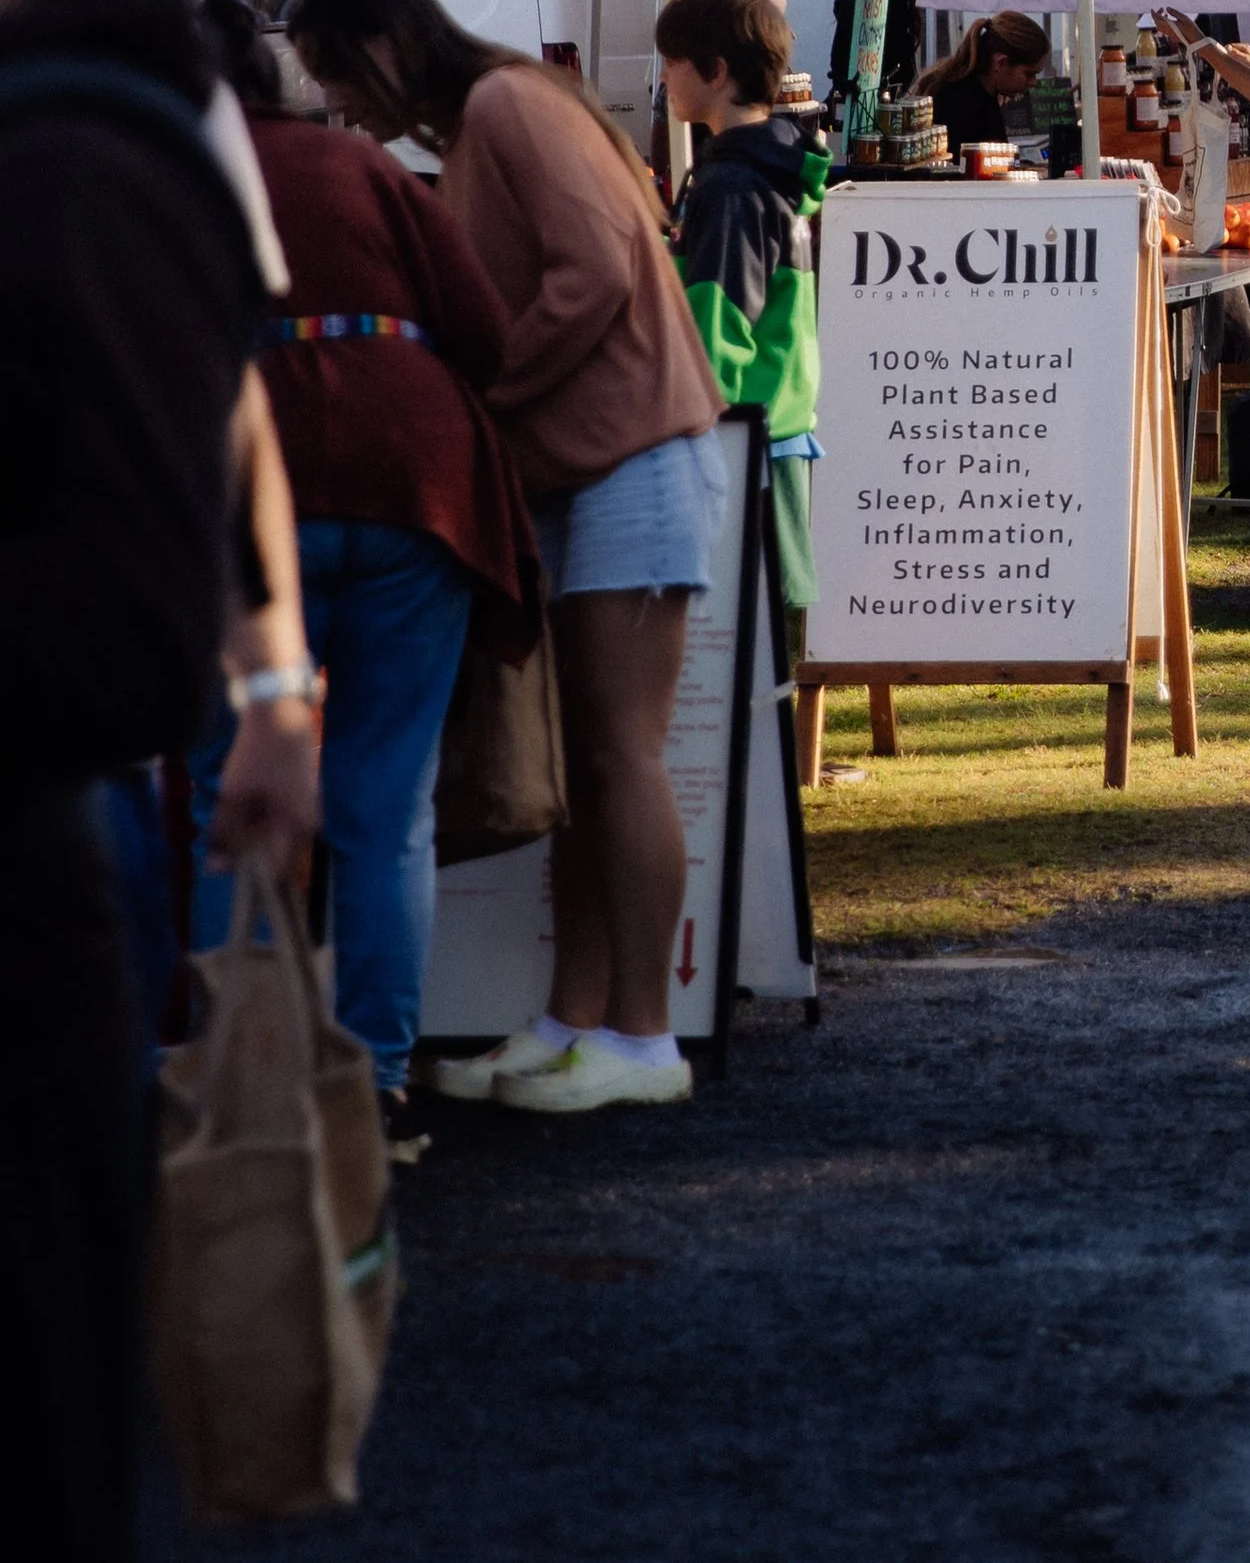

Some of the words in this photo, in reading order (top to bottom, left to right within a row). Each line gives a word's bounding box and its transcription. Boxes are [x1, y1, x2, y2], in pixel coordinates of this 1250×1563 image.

[854, 288, 951, 301] Organic
[970, 288, 1030, 298] Hemp
[1050, 285, 1098, 297] Oils
[869, 350, 949, 371] 100%
[962, 347, 1073, 370] Natural
[882, 384, 958, 405] Plant
[971, 382, 1057, 405] Based
[889, 419, 1048, 440] Assistance
[903, 454, 945, 474] for
[959, 454, 1031, 477] Pain,
[857, 489, 945, 514] Sleep,
[958, 489, 1083, 514] Anxiety,
[864, 523, 1073, 547] Inflammation,
[893, 559, 985, 580] Stress
[998, 557, 1050, 579] and
[849, 593, 1075, 619] Neurodiversity
